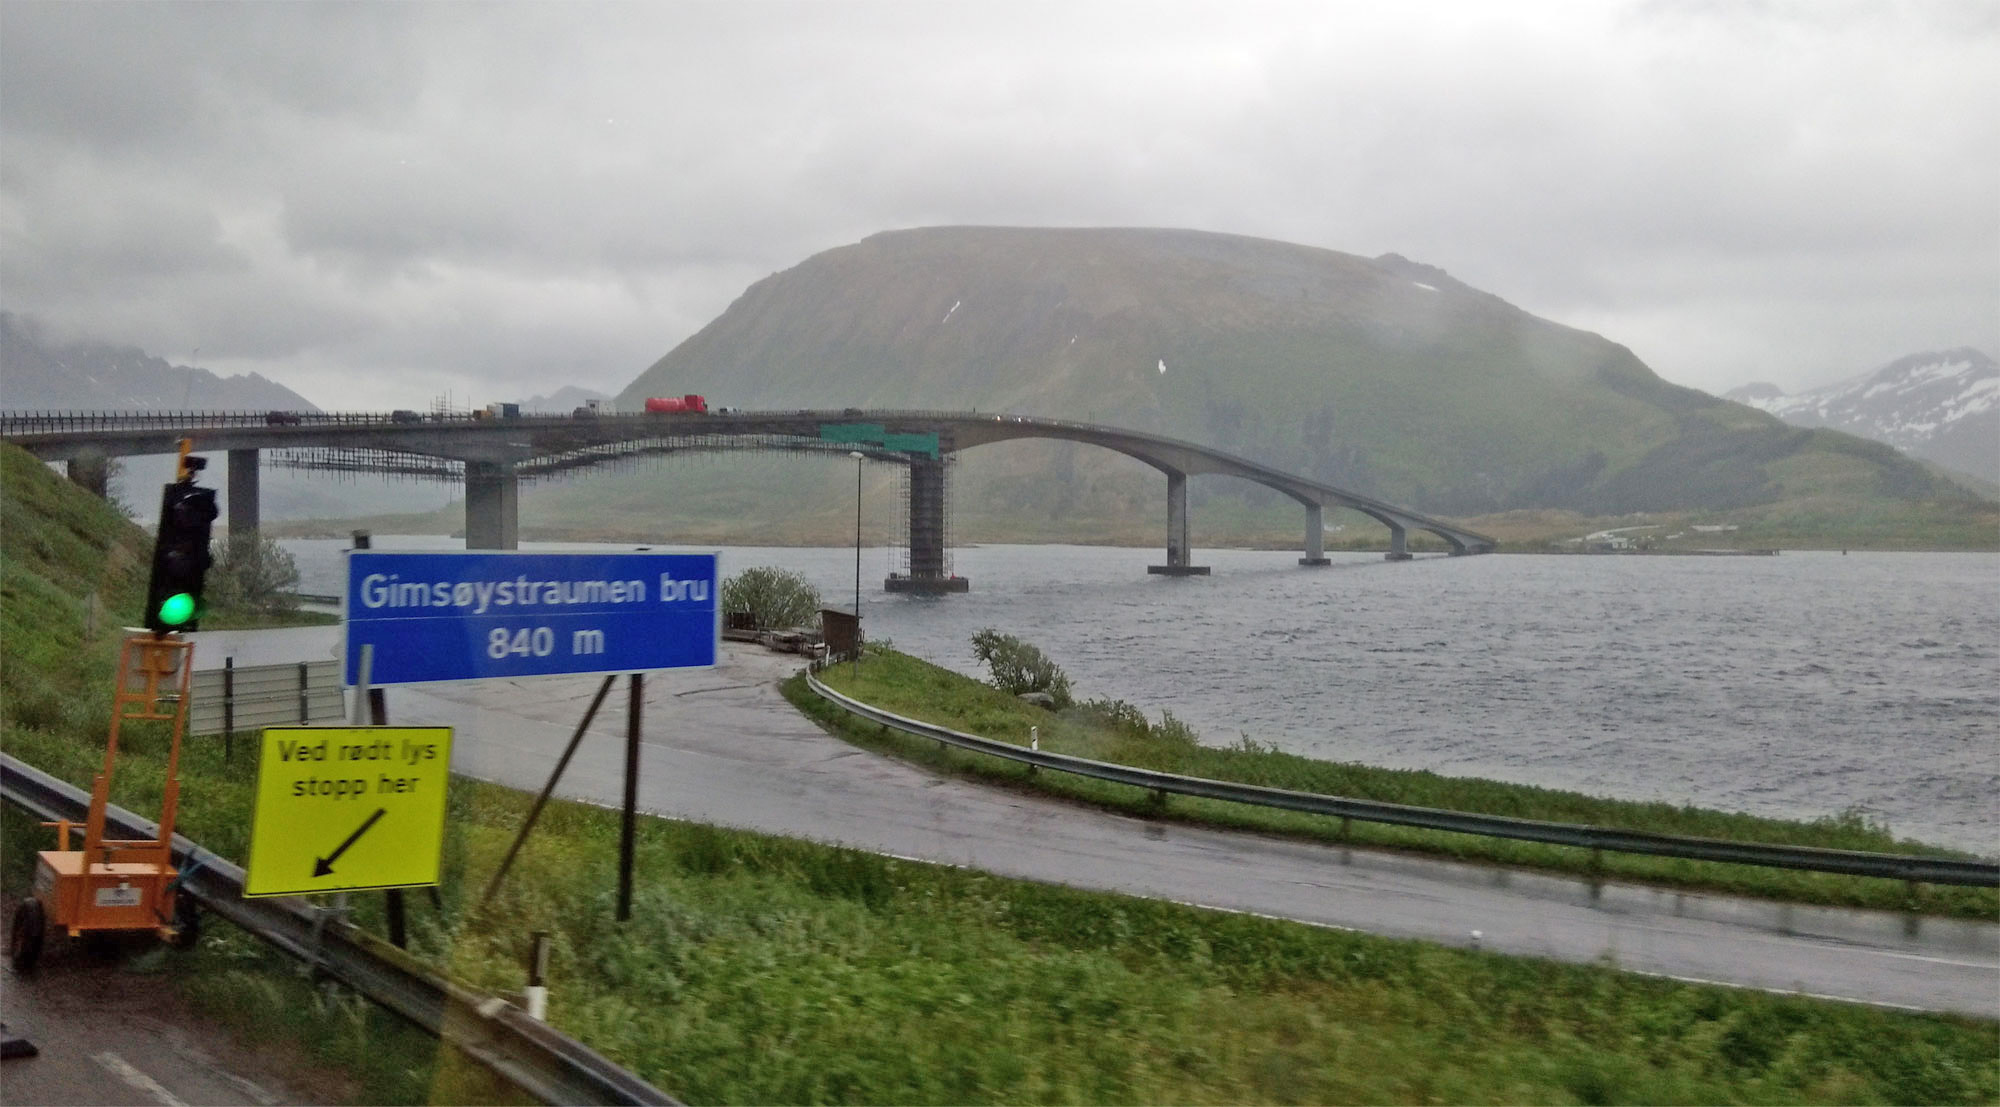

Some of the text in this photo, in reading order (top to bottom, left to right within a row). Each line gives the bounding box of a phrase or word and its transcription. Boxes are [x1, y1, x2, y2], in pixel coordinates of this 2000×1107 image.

[361, 572, 709, 614] Gimsøystraumen bru
[488, 627, 605, 659] 840 m
[278, 739, 437, 765] Ved rødt lys
[292, 774, 420, 801] stopp her
